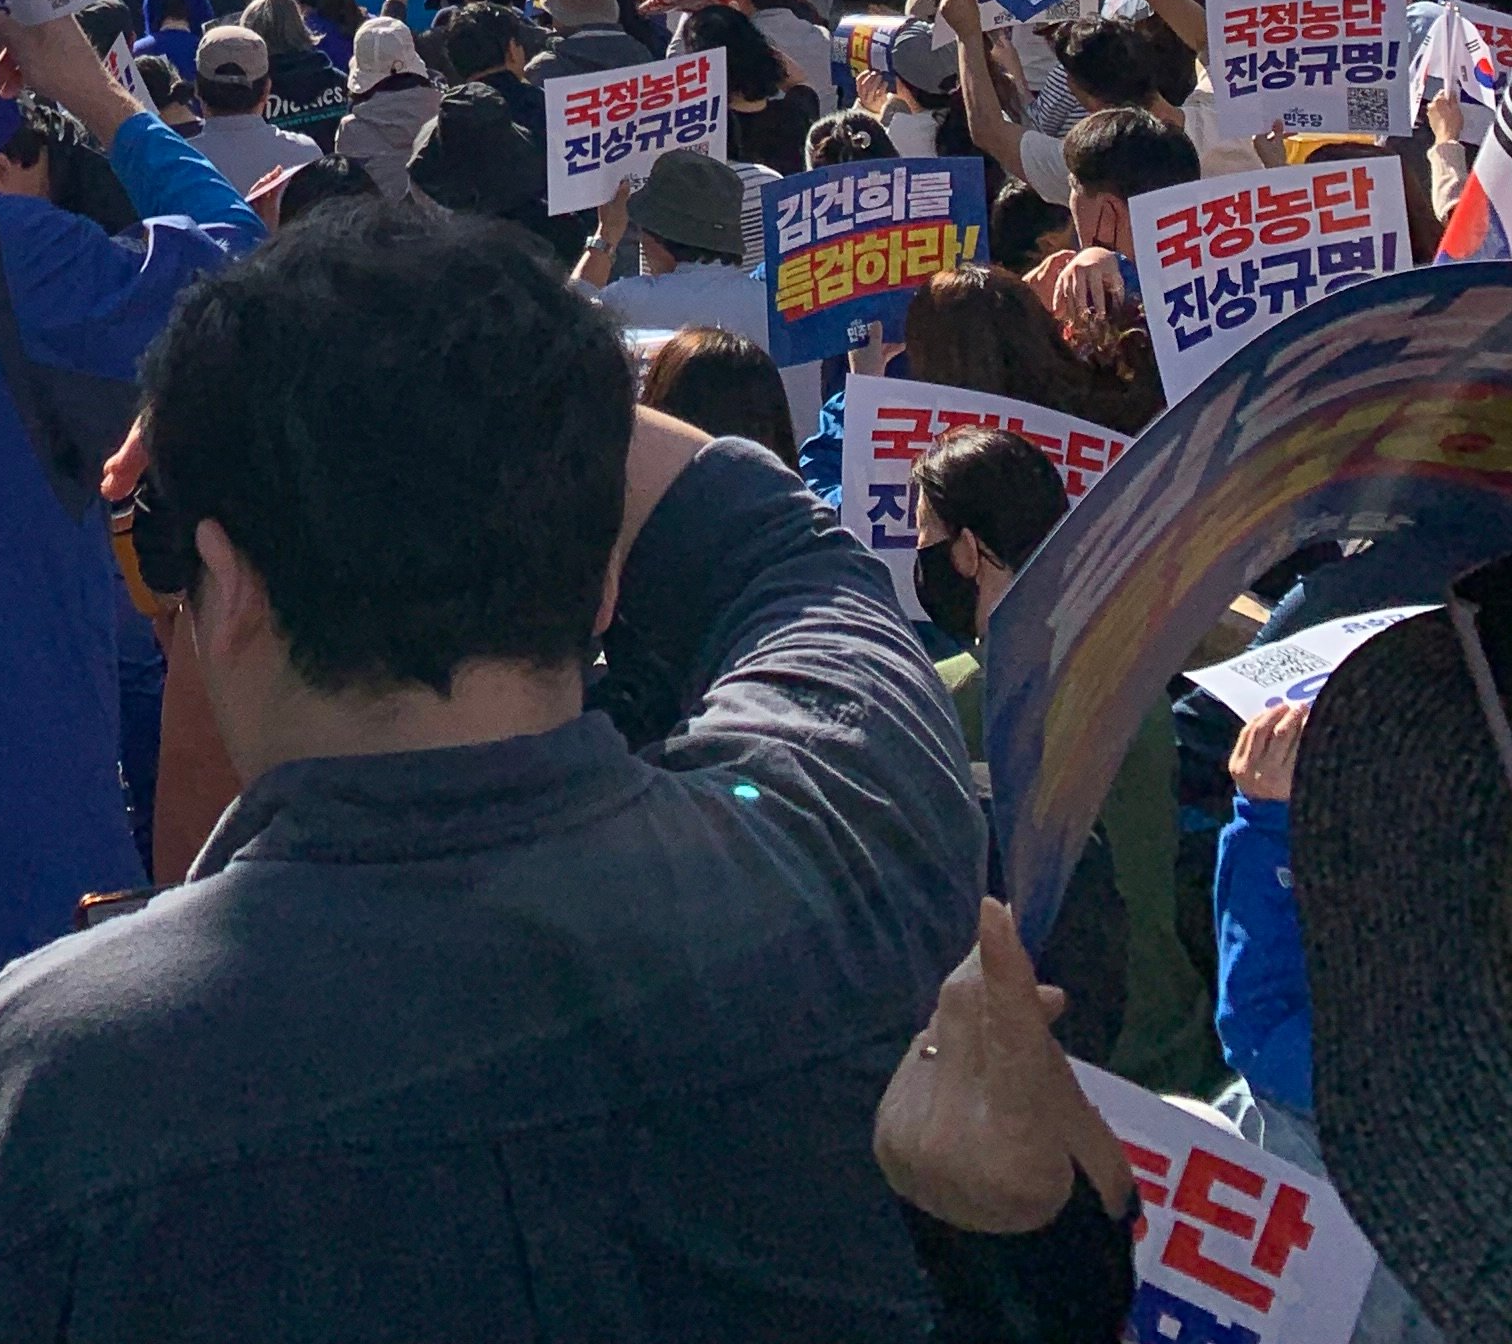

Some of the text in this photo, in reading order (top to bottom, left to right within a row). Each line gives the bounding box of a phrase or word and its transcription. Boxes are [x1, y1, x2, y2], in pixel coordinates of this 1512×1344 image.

[565, 56, 710, 128] 국정농단
[1225, 41, 1400, 98] 진상규명!
[565, 96, 720, 176] 진상규명!
[1283, 114, 1323, 127] 민주당
[776, 167, 953, 253] 김건희를
[1157, 168, 1375, 270] 국정농단
[775, 226, 983, 313] 특검하라!
[1164, 232, 1398, 353] 진상규명!
